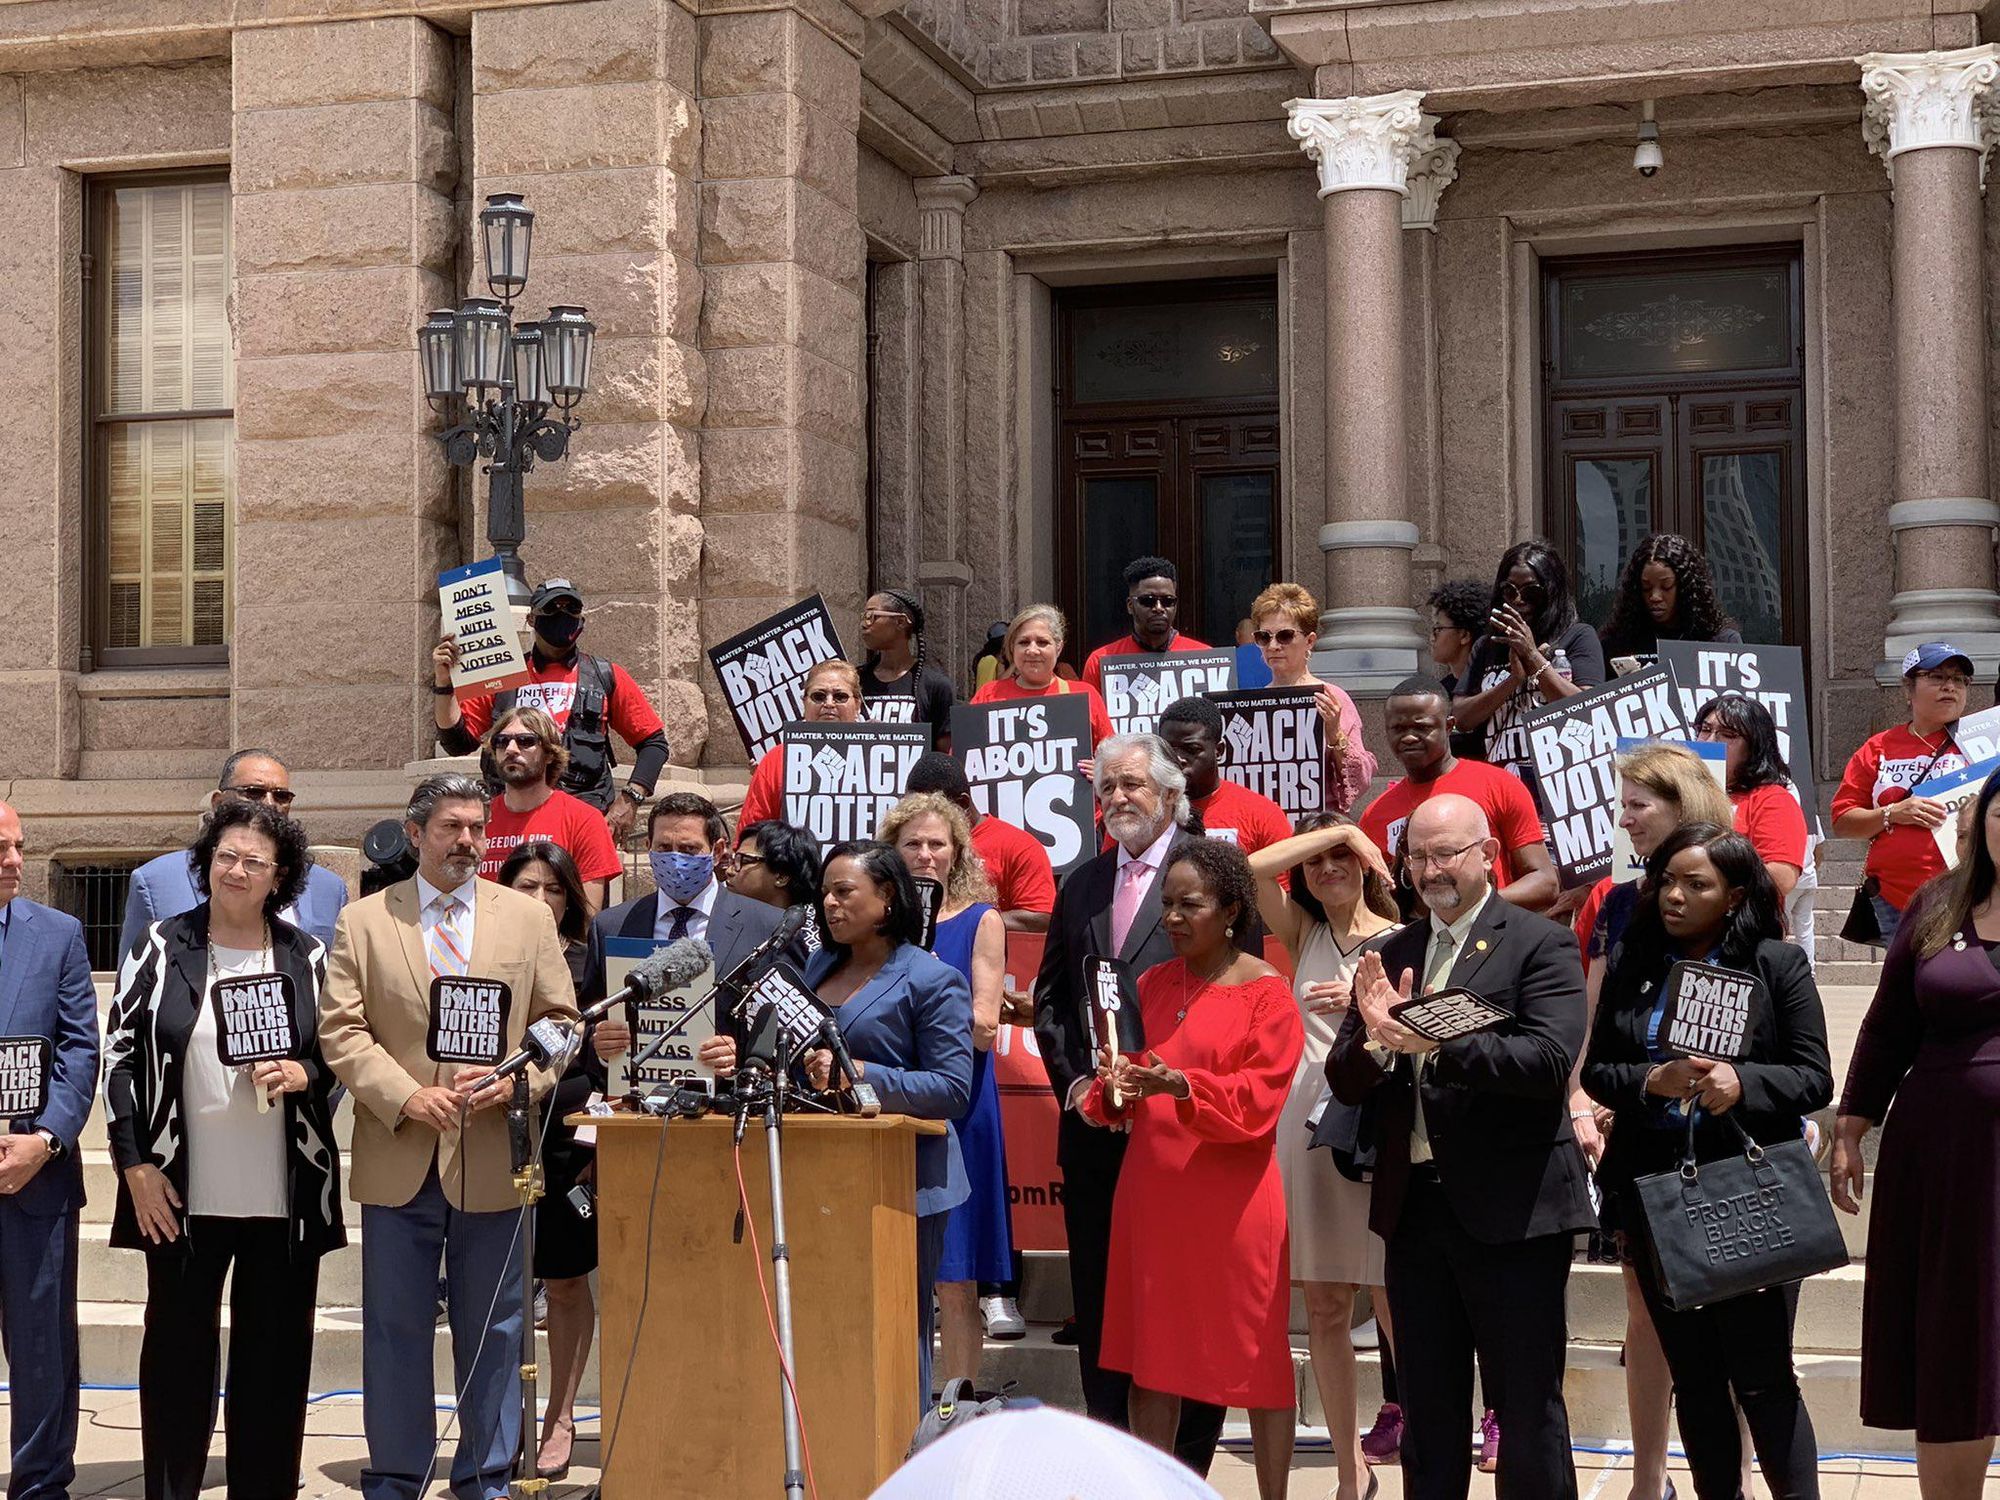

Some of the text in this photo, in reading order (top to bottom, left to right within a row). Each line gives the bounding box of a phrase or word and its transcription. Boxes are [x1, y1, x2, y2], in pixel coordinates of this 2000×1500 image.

[453, 583, 488, 602] DON'T
[456, 601, 492, 618] MESS
[460, 618, 493, 636] WITH
[744, 638, 758, 649] YOU
[783, 620, 794, 629] WE
[459, 635, 504, 653] TEXAS
[460, 651, 513, 670] VOTERS
[720, 616, 838, 706] BACK
[1107, 663, 1138, 671] MATTER.
[1157, 660, 1187, 668] MATTER.
[1698, 651, 1761, 689] IT'S
[1105, 666, 1231, 717] BACK
[1251, 699, 1278, 707] MATTER.
[1532, 712, 1565, 727] MATTER.
[1565, 702, 1583, 714] YOU
[1585, 691, 1619, 708] MATTER.
[1619, 685, 1633, 695] WE
[1634, 673, 1668, 689] MATTER.
[736, 671, 808, 742] VOTE
[844, 733, 877, 741] MATTER.
[988, 704, 1048, 743] IT'S
[1530, 682, 1680, 776] BACK
[786, 743, 924, 794] BACK
[964, 738, 1078, 782] ABOUT
[221, 982, 285, 1012] BACK
[440, 985, 502, 1012] BACK
[639, 996, 686, 1010] ESS
[1097, 981, 1121, 1010] US
[1679, 971, 1753, 1011] BACK
[224, 1006, 289, 1034] VOTERS
[440, 1008, 501, 1034] VOTERS
[1401, 1005, 1463, 1039] MATTER
[1676, 996, 1748, 1034] VOTERS
[226, 1027, 292, 1056] MATTER
[436, 1030, 499, 1056] MATTER
[546, 1028, 566, 1048] CBS
[1668, 1019, 1743, 1057] MATTER
[0, 1067, 41, 1090] TERS
[0, 1088, 40, 1110] TTER
[1685, 1184, 1784, 1228] PROTECT
[1705, 1207, 1783, 1243] BLACK
[1706, 1226, 1795, 1265] PEOPLE
